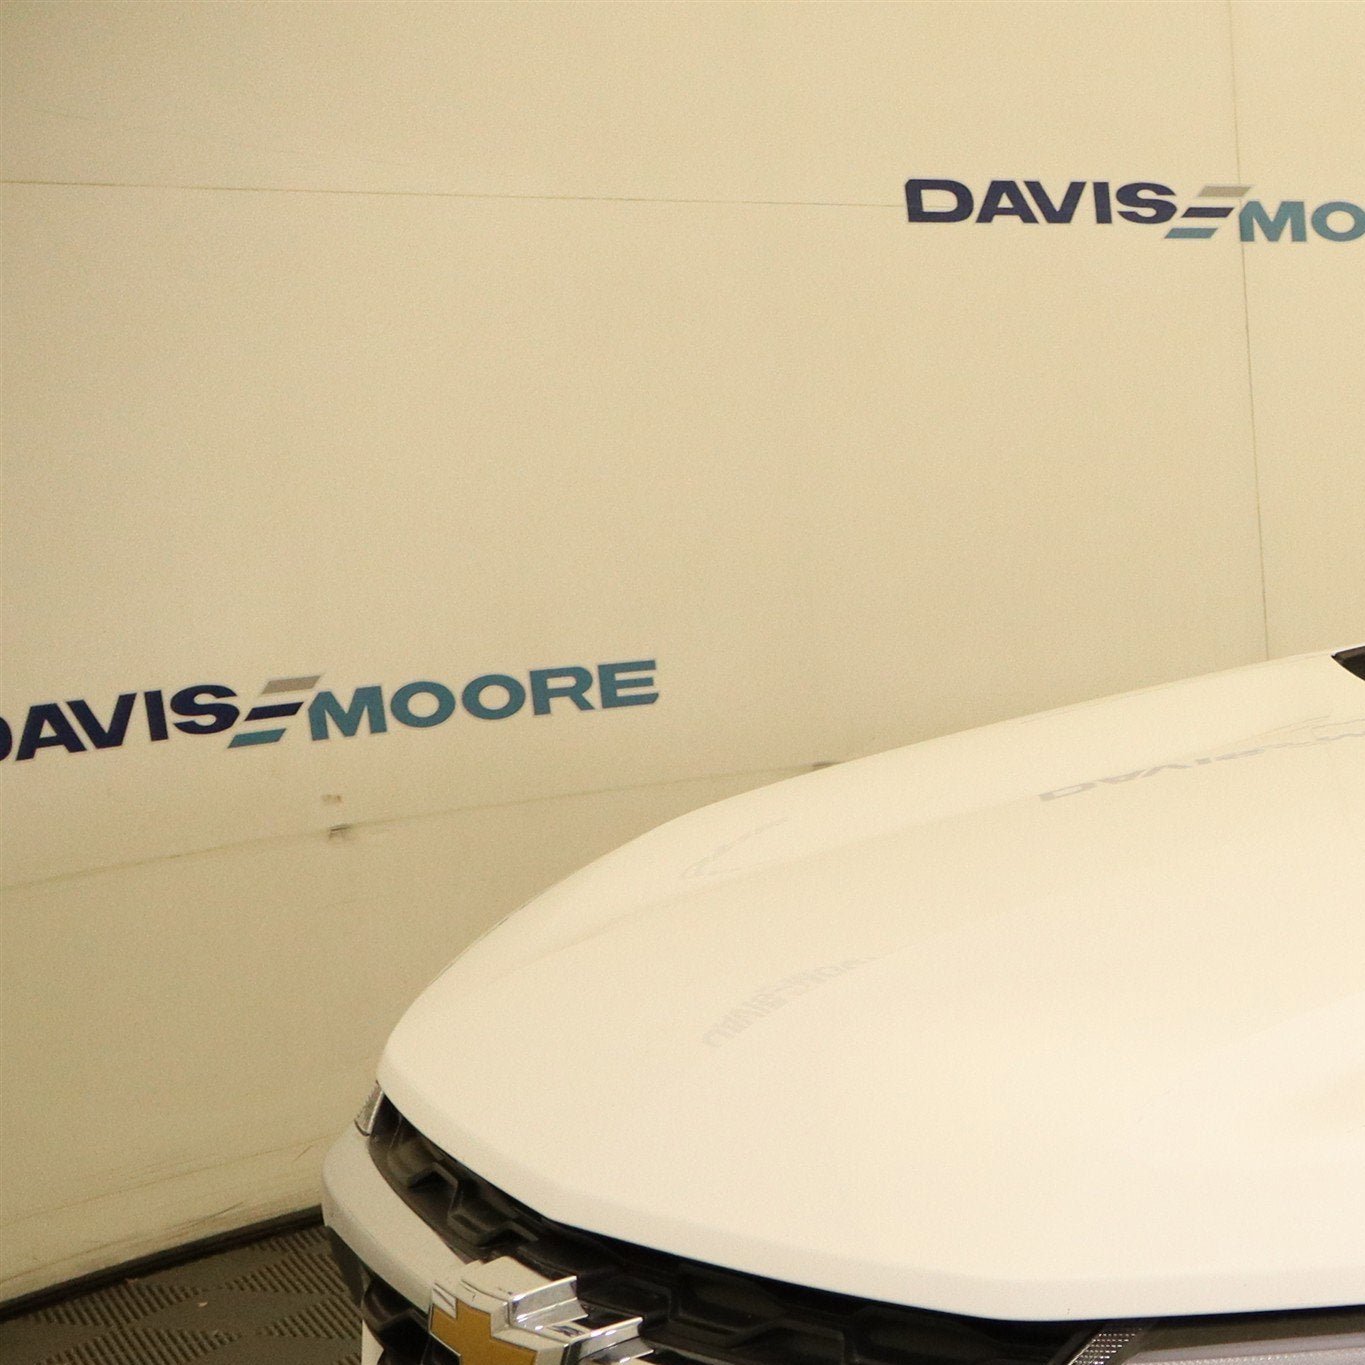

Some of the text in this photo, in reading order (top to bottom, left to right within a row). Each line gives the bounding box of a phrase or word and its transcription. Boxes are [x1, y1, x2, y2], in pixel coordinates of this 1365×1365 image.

[904, 178, 1178, 225] DAVIS
[0, 659, 660, 763] AVIS MOORE
